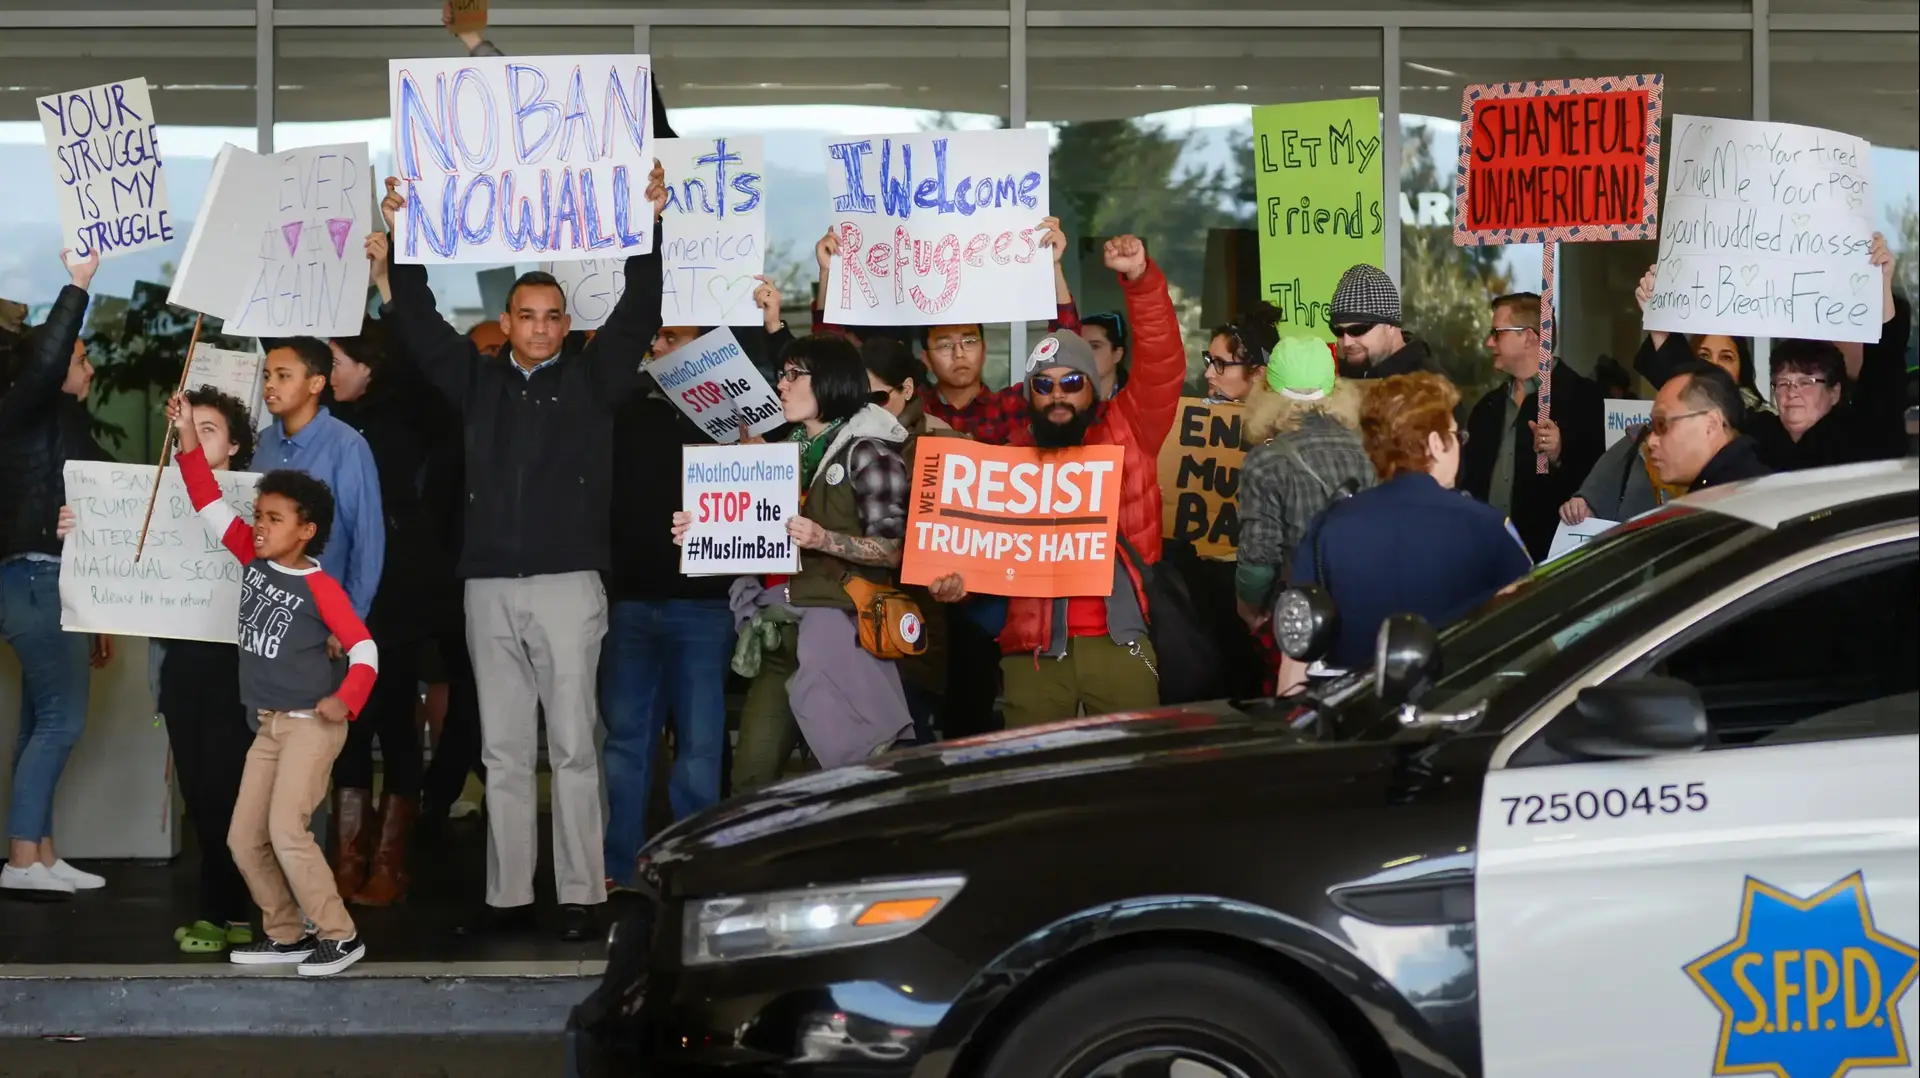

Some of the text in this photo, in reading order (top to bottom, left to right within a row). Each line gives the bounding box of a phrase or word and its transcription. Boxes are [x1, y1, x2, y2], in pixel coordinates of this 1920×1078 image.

[41, 83, 143, 138] YOUR
[395, 63, 648, 180] NO BAN
[1475, 95, 1646, 163] SHAMEFUL!
[57, 124, 163, 186] STRUGGLE
[1261, 118, 1380, 174] LET My
[1674, 123, 1858, 202] Give Me Your tired
[76, 164, 157, 220] IS MY
[828, 140, 877, 214] I
[1471, 164, 1640, 225] UNAMERICAN!
[1769, 169, 1823, 205] Your
[75, 210, 174, 259] STRUGGLE
[405, 165, 644, 259] NO WALL
[1268, 191, 1382, 238] Friends
[1661, 204, 1873, 262] your huddled masses
[661, 230, 760, 261] merica
[840, 221, 1036, 314] Refugees
[236, 261, 347, 329] AGAIN
[572, 266, 717, 321] GRAT
[1270, 277, 1332, 328] Thro
[1652, 265, 1868, 326] earning to Breathe Free
[657, 342, 740, 390] #NotInOurName
[681, 377, 751, 413] STOP the
[1179, 405, 1242, 449] EN
[687, 460, 794, 483] #NotInOurName
[918, 453, 940, 514] WE WILL
[940, 453, 1114, 515] RESIST
[1176, 453, 1240, 499] MU
[699, 491, 781, 523] STOP the
[73, 528, 183, 547] INTERESTS
[688, 535, 791, 560] #MuslimBan!
[915, 521, 1033, 562] TRUMP'S
[1038, 532, 1107, 562] HATE
[73, 555, 242, 583] NATIONAL SECURI
[245, 566, 304, 610] THE NEXT
[1500, 782, 1709, 826] 72500455
[1732, 947, 1884, 1036] S.F.P.D.
